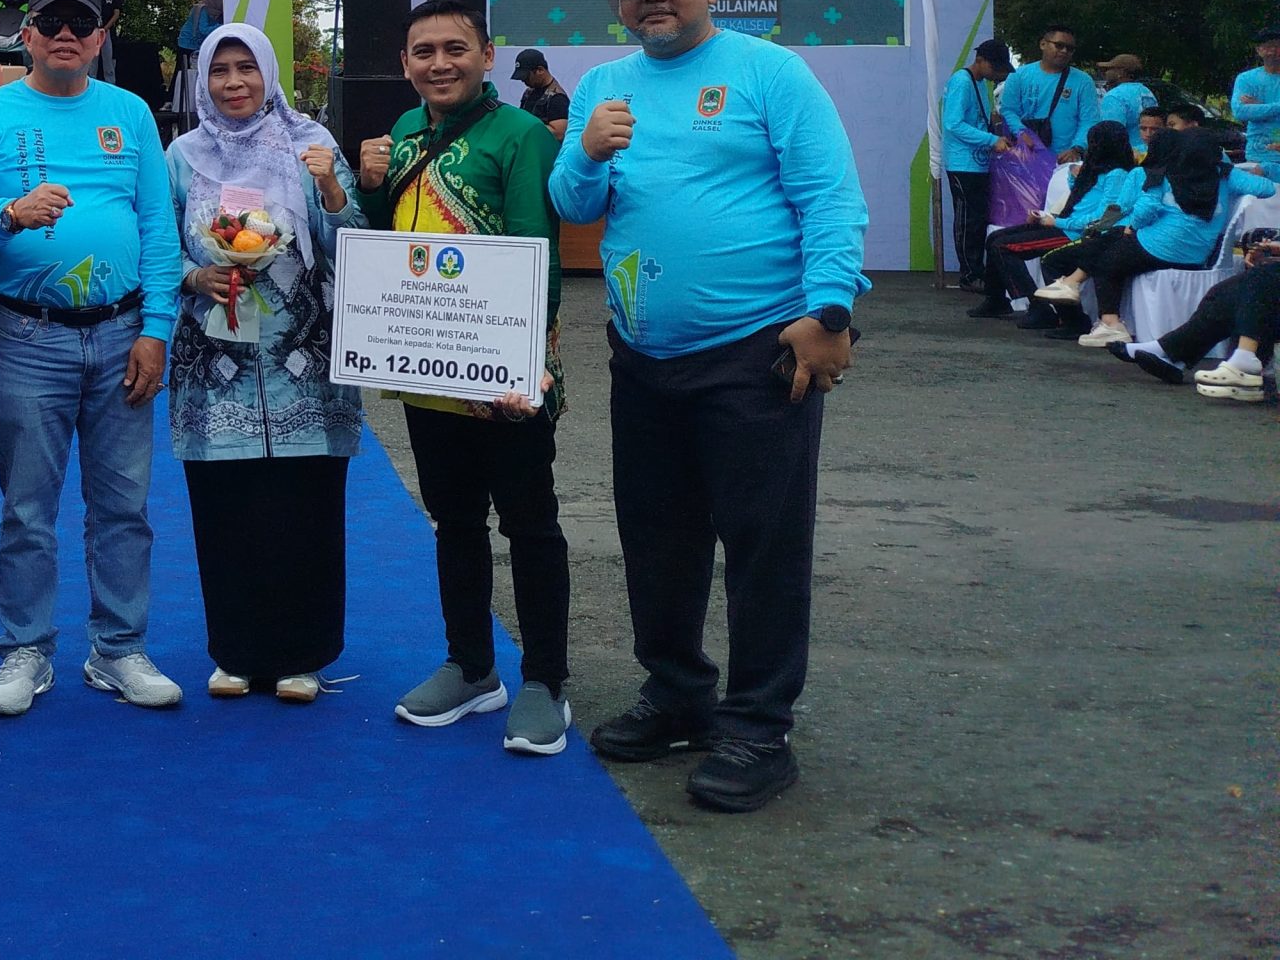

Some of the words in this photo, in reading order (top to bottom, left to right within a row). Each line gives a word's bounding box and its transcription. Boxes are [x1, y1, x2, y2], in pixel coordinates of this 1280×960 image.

[728, 19, 770, 31] KALSEL
[400, 280, 468, 294] PENGHARGAAN
[381, 292, 432, 306] KABUPATAN
[433, 295, 457, 308] KOTA
[459, 298, 489, 310] SEHAT
[346, 303, 383, 316] TINGKAT
[383, 306, 424, 320] PROVINSI
[425, 310, 484, 324] KALIMANTAN
[485, 315, 527, 328] SELATAN
[387, 324, 434, 337] KATEGORI
[436, 328, 479, 341] WISTARA
[367, 334, 403, 346] Diberikan
[404, 338, 435, 350] kepada:
[436, 341, 454, 351] Kota
[456, 343, 501, 356] Banjarbaru
[344, 350, 377, 373] Rp.
[385, 354, 524, 389] 12.000.000,-
